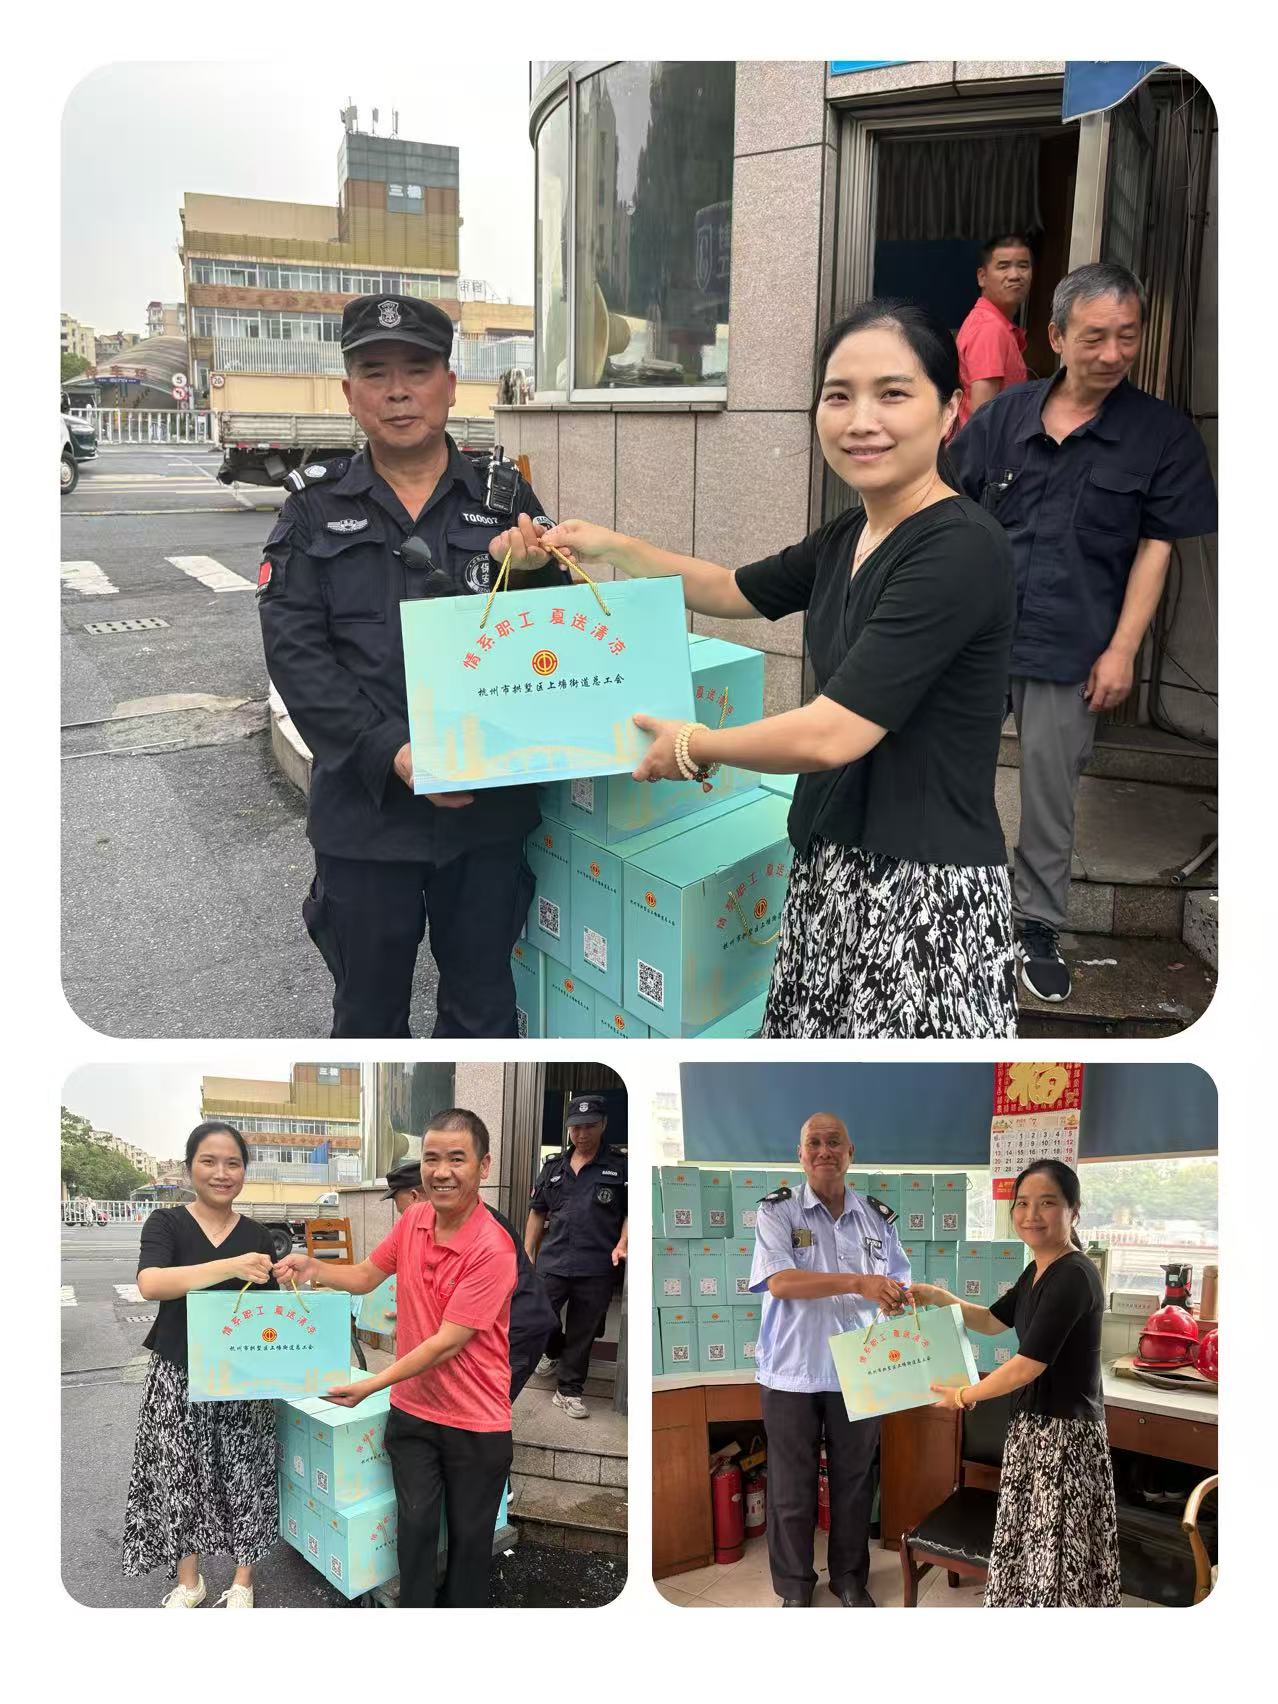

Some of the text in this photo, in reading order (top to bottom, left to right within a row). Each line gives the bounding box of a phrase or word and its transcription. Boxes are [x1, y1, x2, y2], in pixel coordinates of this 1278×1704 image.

[481, 562, 490, 585] 保安
[462, 608, 626, 669] 情系职工 夏送清凉
[478, 673, 625, 696] 杭州市拱墅区上塘街道总工会
[1007, 1063, 1069, 1107] 福
